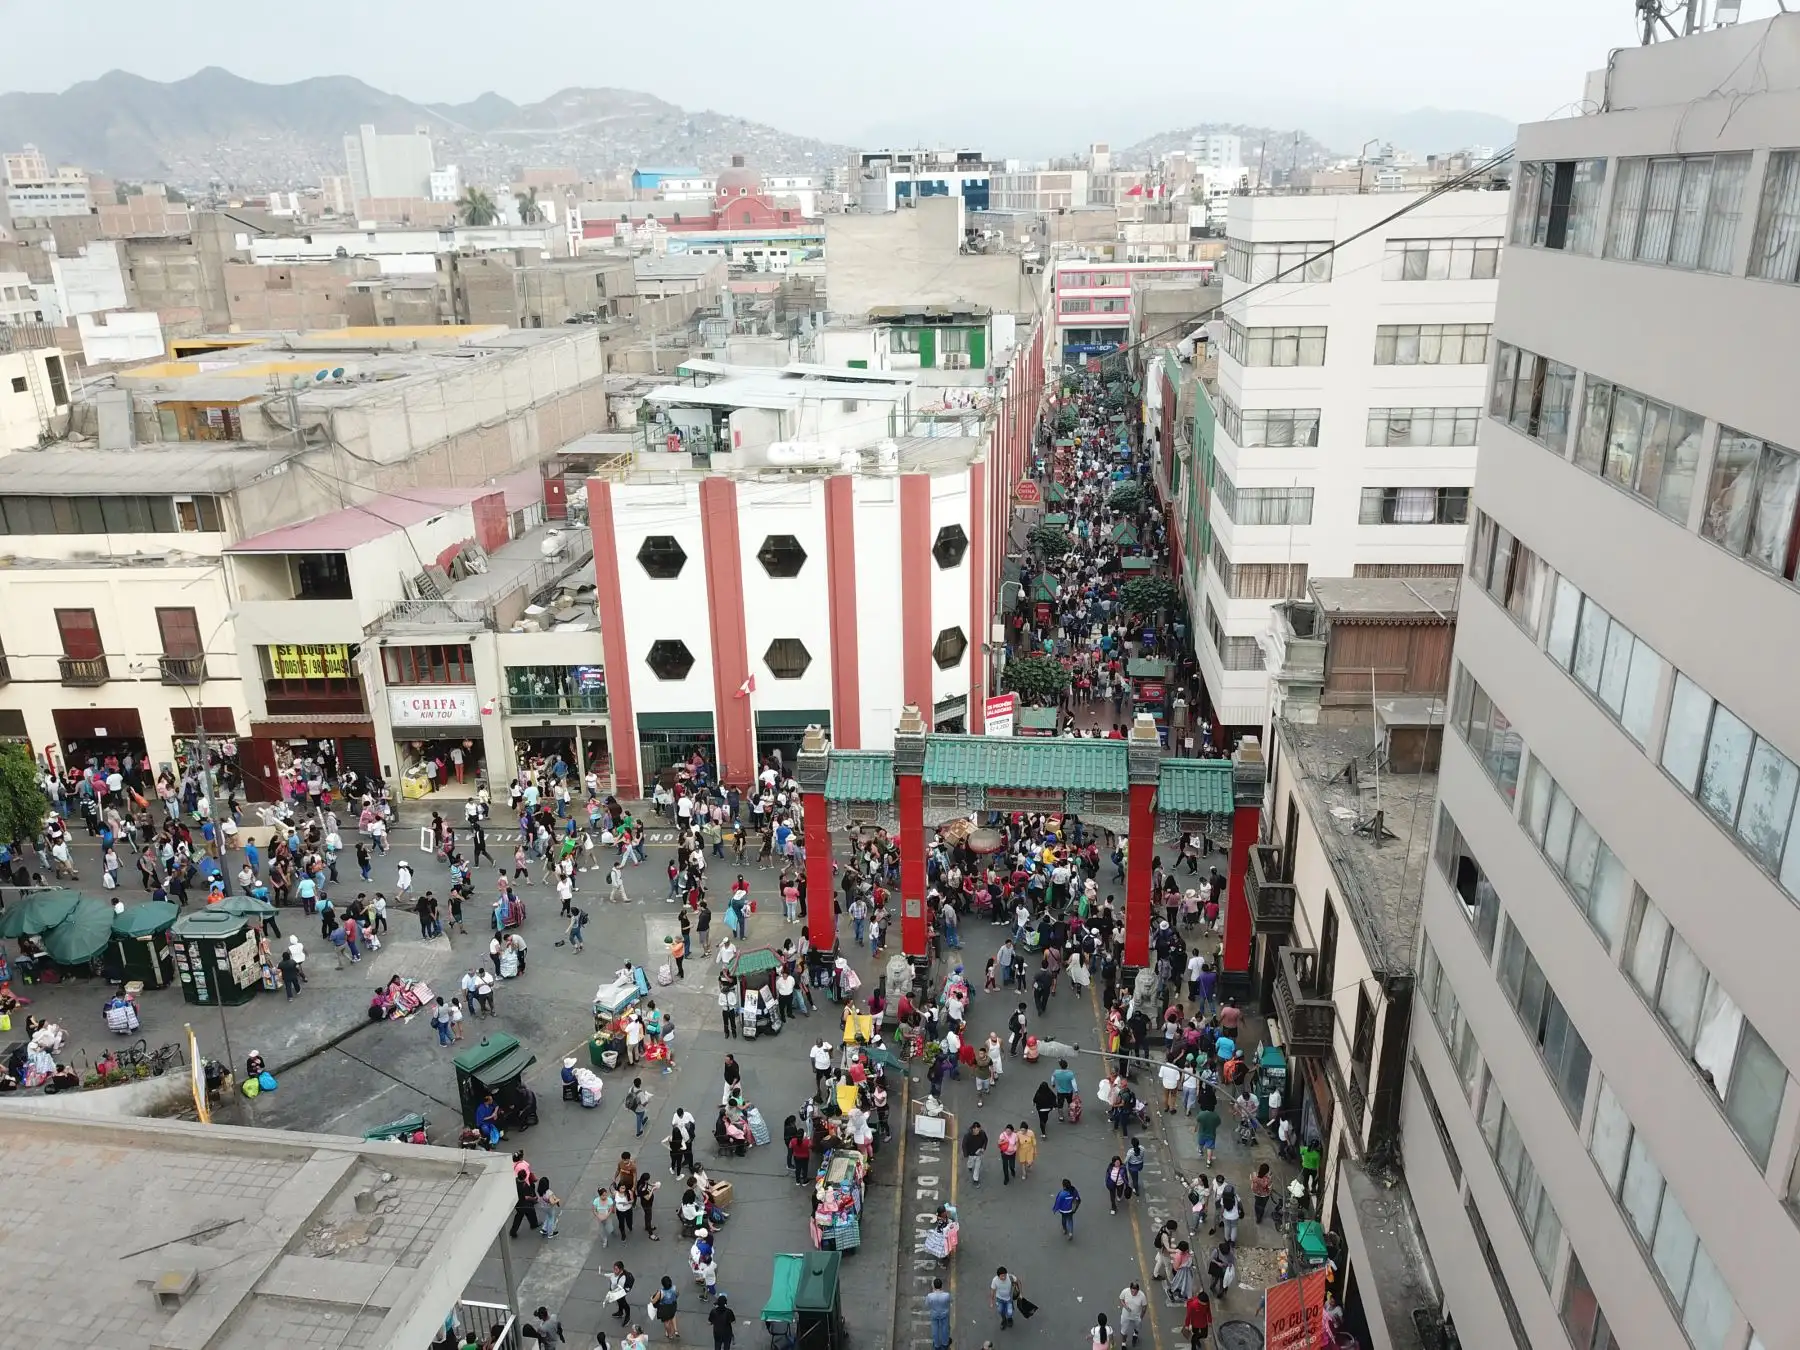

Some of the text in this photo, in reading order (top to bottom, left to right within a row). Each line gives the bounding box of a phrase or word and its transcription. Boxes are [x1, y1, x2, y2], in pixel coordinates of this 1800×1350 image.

[279, 645, 338, 656] SE ALQULA
[412, 699, 457, 710] CHIFA
[420, 711, 434, 719] KIN
[916, 1175, 939, 1200] DE
[1272, 1305, 1319, 1335] YO CUDO
